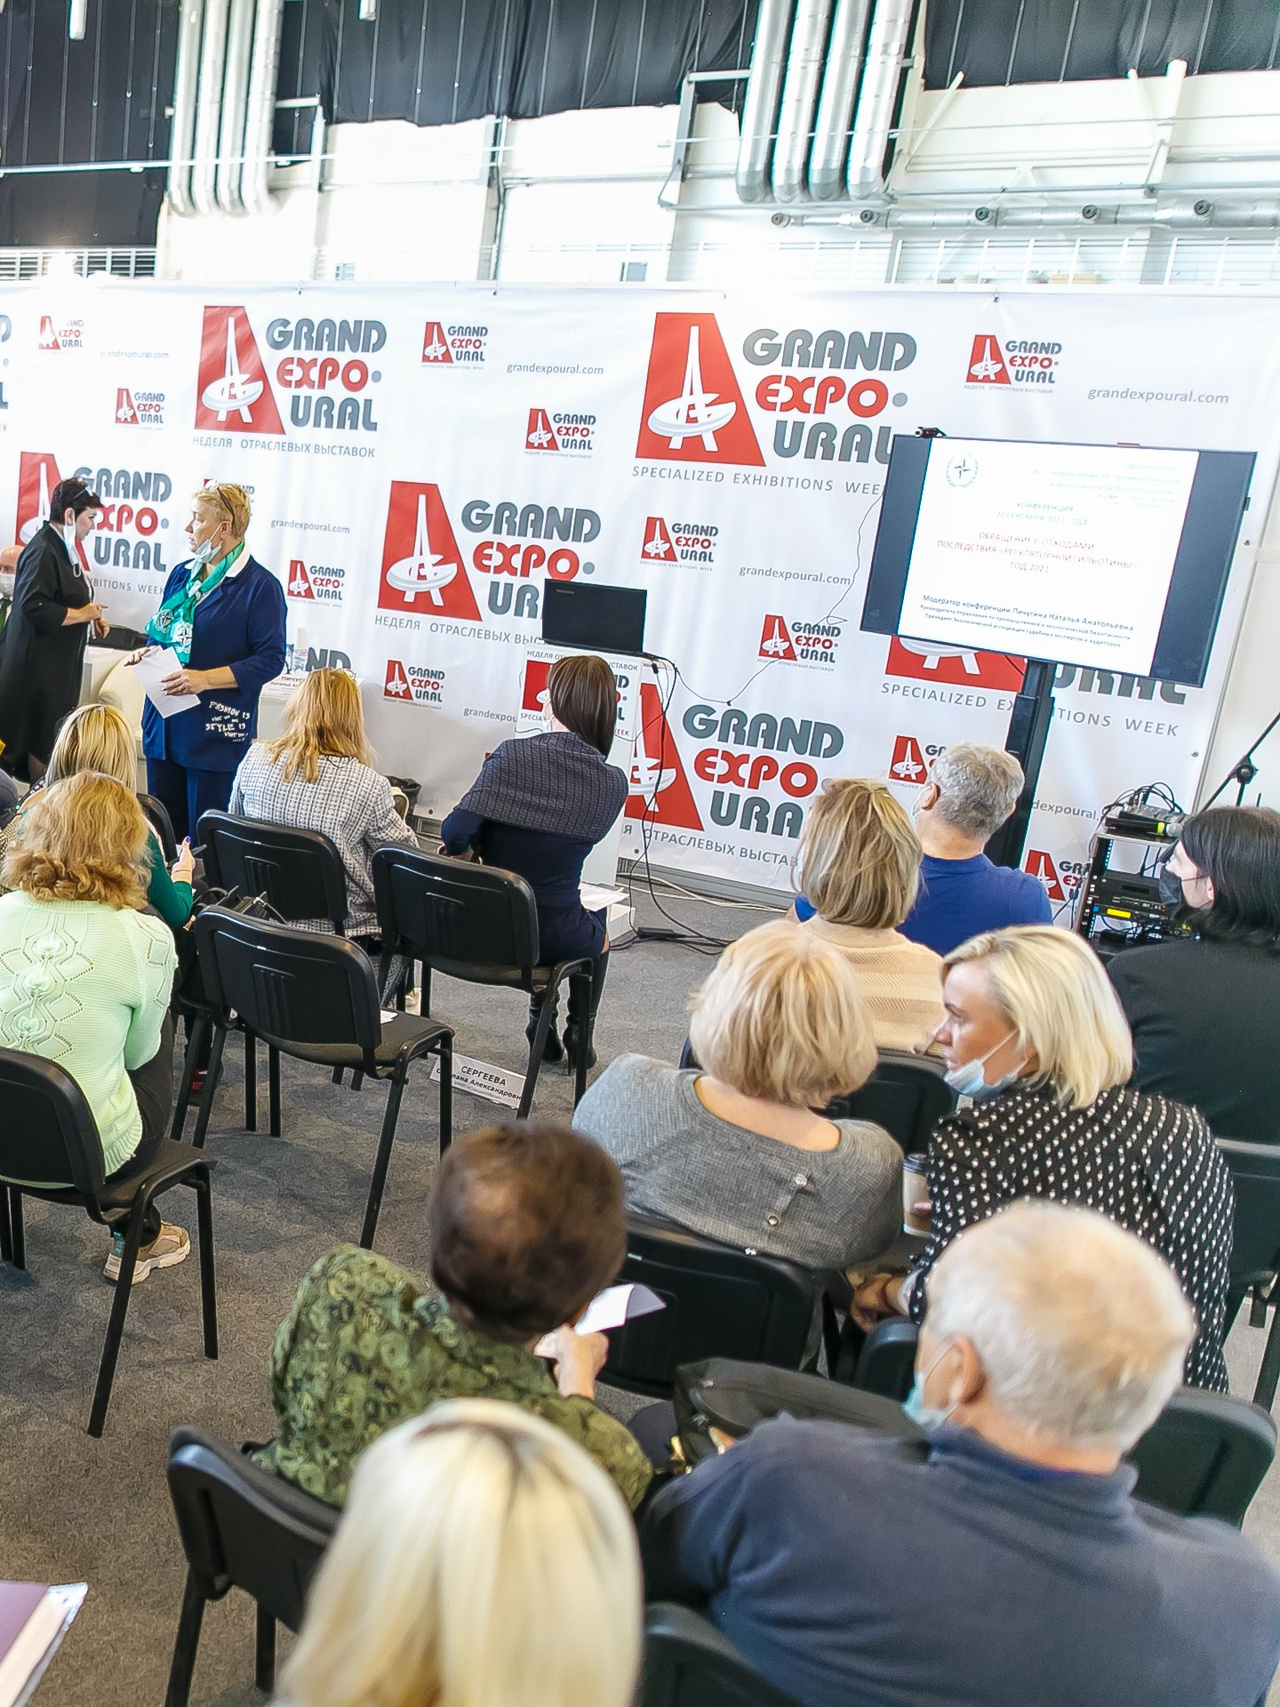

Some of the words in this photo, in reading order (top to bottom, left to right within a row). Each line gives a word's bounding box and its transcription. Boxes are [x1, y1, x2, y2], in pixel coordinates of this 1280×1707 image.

[265, 318, 387, 353] GRAND
[447, 326, 488, 337] GRAND
[62, 339, 83, 348] URAL
[450, 338, 482, 350] EXPO
[742, 328, 918, 372] GRAND
[1005, 340, 1063, 355] GRAND
[455, 350, 485, 362] URAL
[1008, 355, 1053, 369] EXPO
[276, 357, 369, 392] EXPO
[506, 362, 605, 376] grandexpoural.com
[1014, 369, 1056, 385] URAL
[133, 391, 165, 402] GRAND
[755, 374, 889, 418] EXPO
[1087, 388, 1229, 404] grandexpoural.com
[137, 403, 161, 413] EXPO
[290, 395, 378, 431] URAL
[140, 413, 164, 424] URAL
[553, 413, 597, 426] GRAND
[556, 426, 590, 438] EXPO
[192, 436, 233, 449] НЕДЕЛЯ
[240, 439, 312, 454] ОТРАСЛЕВЫХ
[314, 444, 375, 458] ВЫСТАВОК
[561, 438, 593, 451] URAL
[773, 420, 893, 465] URAL
[632, 466, 725, 483] SPECIALIZED
[733, 473, 834, 492] EXHIBITIONS
[845, 482, 884, 497] WEE
[1016, 501, 1074, 512] КОНФЕРЕНЦИЯ
[96, 503, 159, 536] XPO
[271, 519, 350, 534] grandexpoural.com
[461, 499, 602, 543] GRAND
[671, 522, 719, 537] GRAND
[675, 536, 711, 548] EXPO
[937, 539, 997, 553] ПОСЛЕДСТВИЯ
[978, 531, 1031, 543] ОБРАЩЕНИЕ
[1041, 538, 1095, 550] ОТХОДАМИ
[93, 536, 167, 572] URAL
[472, 540, 580, 580] EXPO
[680, 549, 714, 563] URAL
[309, 565, 345, 578] GRAND
[1009, 561, 1028, 571] ГОД
[1029, 563, 1050, 573] 2021
[312, 577, 340, 589] EXPO
[739, 565, 851, 586] grandexpoural.com
[316, 588, 343, 600] URAL
[487, 581, 542, 619] UR
[922, 595, 961, 607] Модератор
[962, 601, 1011, 614] конференции
[1012, 606, 1048, 620] Пичугина
[1049, 612, 1080, 624] Наталья
[1082, 617, 1134, 632] Анатольевна
[375, 614, 420, 632] НЕДЕЛЯ
[429, 621, 511, 644] ОТРАСЛЕВЫХ
[791, 621, 841, 637] GRAND
[795, 635, 833, 649] EXPO
[526, 650, 553, 659] НЕДЕЛЯ
[799, 648, 836, 663] URAL
[407, 666, 445, 680] GRAND
[410, 678, 441, 691] EXPO
[415, 689, 443, 703] URAL
[463, 708, 518, 723] grandexpou
[520, 712, 545, 721] SPECIA
[881, 682, 987, 708] SPECIALIZED
[1125, 718, 1179, 737] WEEK
[205, 722, 236, 732] STYLE
[682, 704, 845, 758] GRAND
[694, 748, 818, 798] EXPO
[710, 790, 804, 839] URA
[644, 829, 735, 856] ОТРАСЛЕВЫХ
[740, 847, 798, 867] ВЫСТАВ
[461, 1065, 506, 1087] СЕРГЕЕВА
[469, 1080, 523, 1100] Александровн
